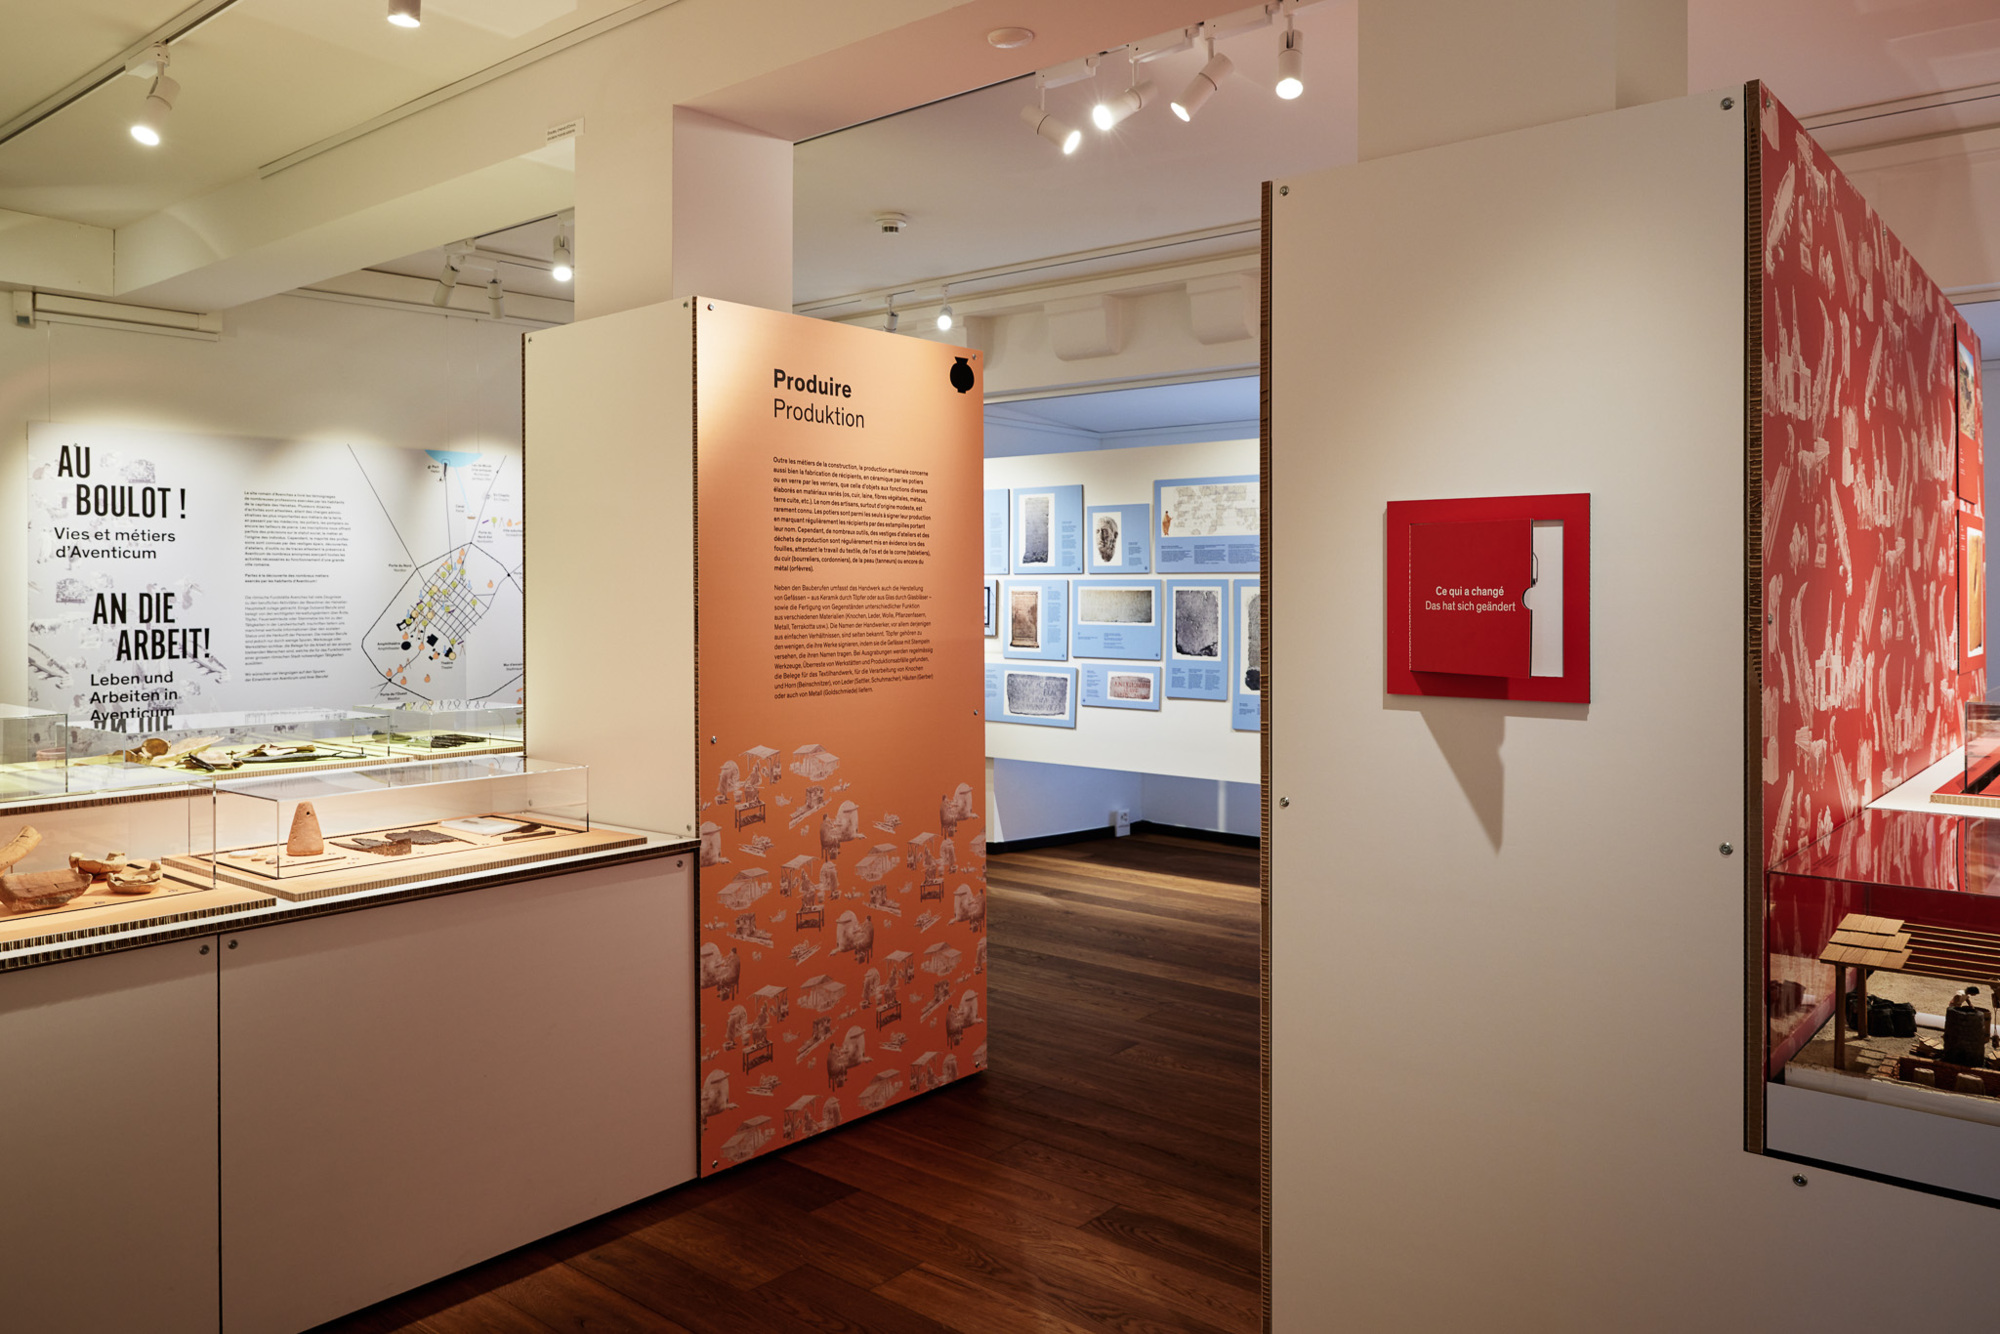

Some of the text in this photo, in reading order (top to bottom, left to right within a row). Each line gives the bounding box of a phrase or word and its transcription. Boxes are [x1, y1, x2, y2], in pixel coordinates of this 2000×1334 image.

[774, 369, 852, 398] Produire
[774, 398, 864, 428] Produktion
[57, 445, 90, 478] AU
[805, 469, 831, 477] fabrication
[76, 484, 171, 518] BOULOT
[54, 527, 176, 542] Vies et métiers
[1436, 586, 1447, 596] Ce
[1449, 586, 1462, 598] qui
[1471, 586, 1504, 598] changé
[92, 592, 175, 624] AN DIE
[1425, 601, 1516, 613] Das hat sich geändert
[116, 628, 210, 661] ARBEIT!
[90, 671, 173, 686] Leben und
[90, 690, 178, 705] Arbeiten in
